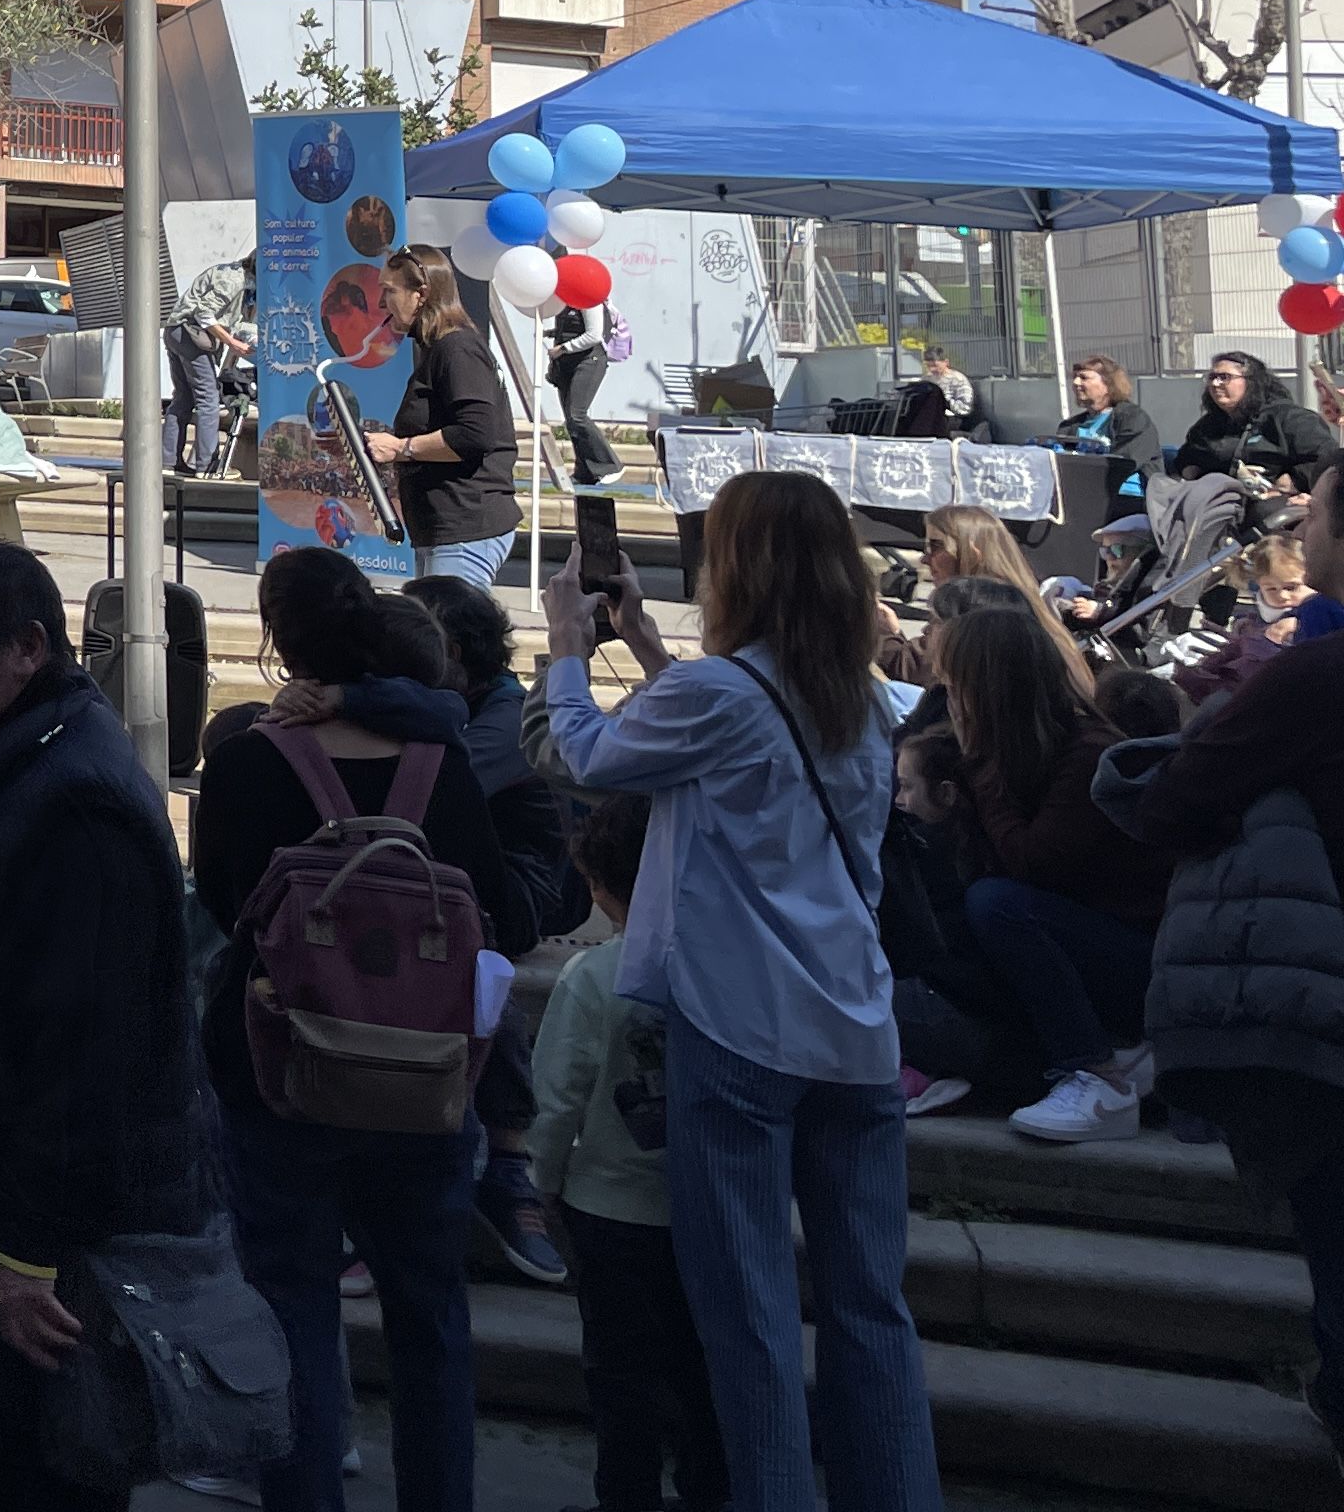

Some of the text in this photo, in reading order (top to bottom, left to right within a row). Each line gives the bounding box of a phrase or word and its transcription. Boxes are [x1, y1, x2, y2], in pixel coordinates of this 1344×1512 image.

[264, 218, 316, 229] Som cultura
[272, 234, 305, 245] popular
[262, 247, 280, 257] Som
[268, 261, 310, 271] de carrer
[351, 553, 407, 572] desdolla
